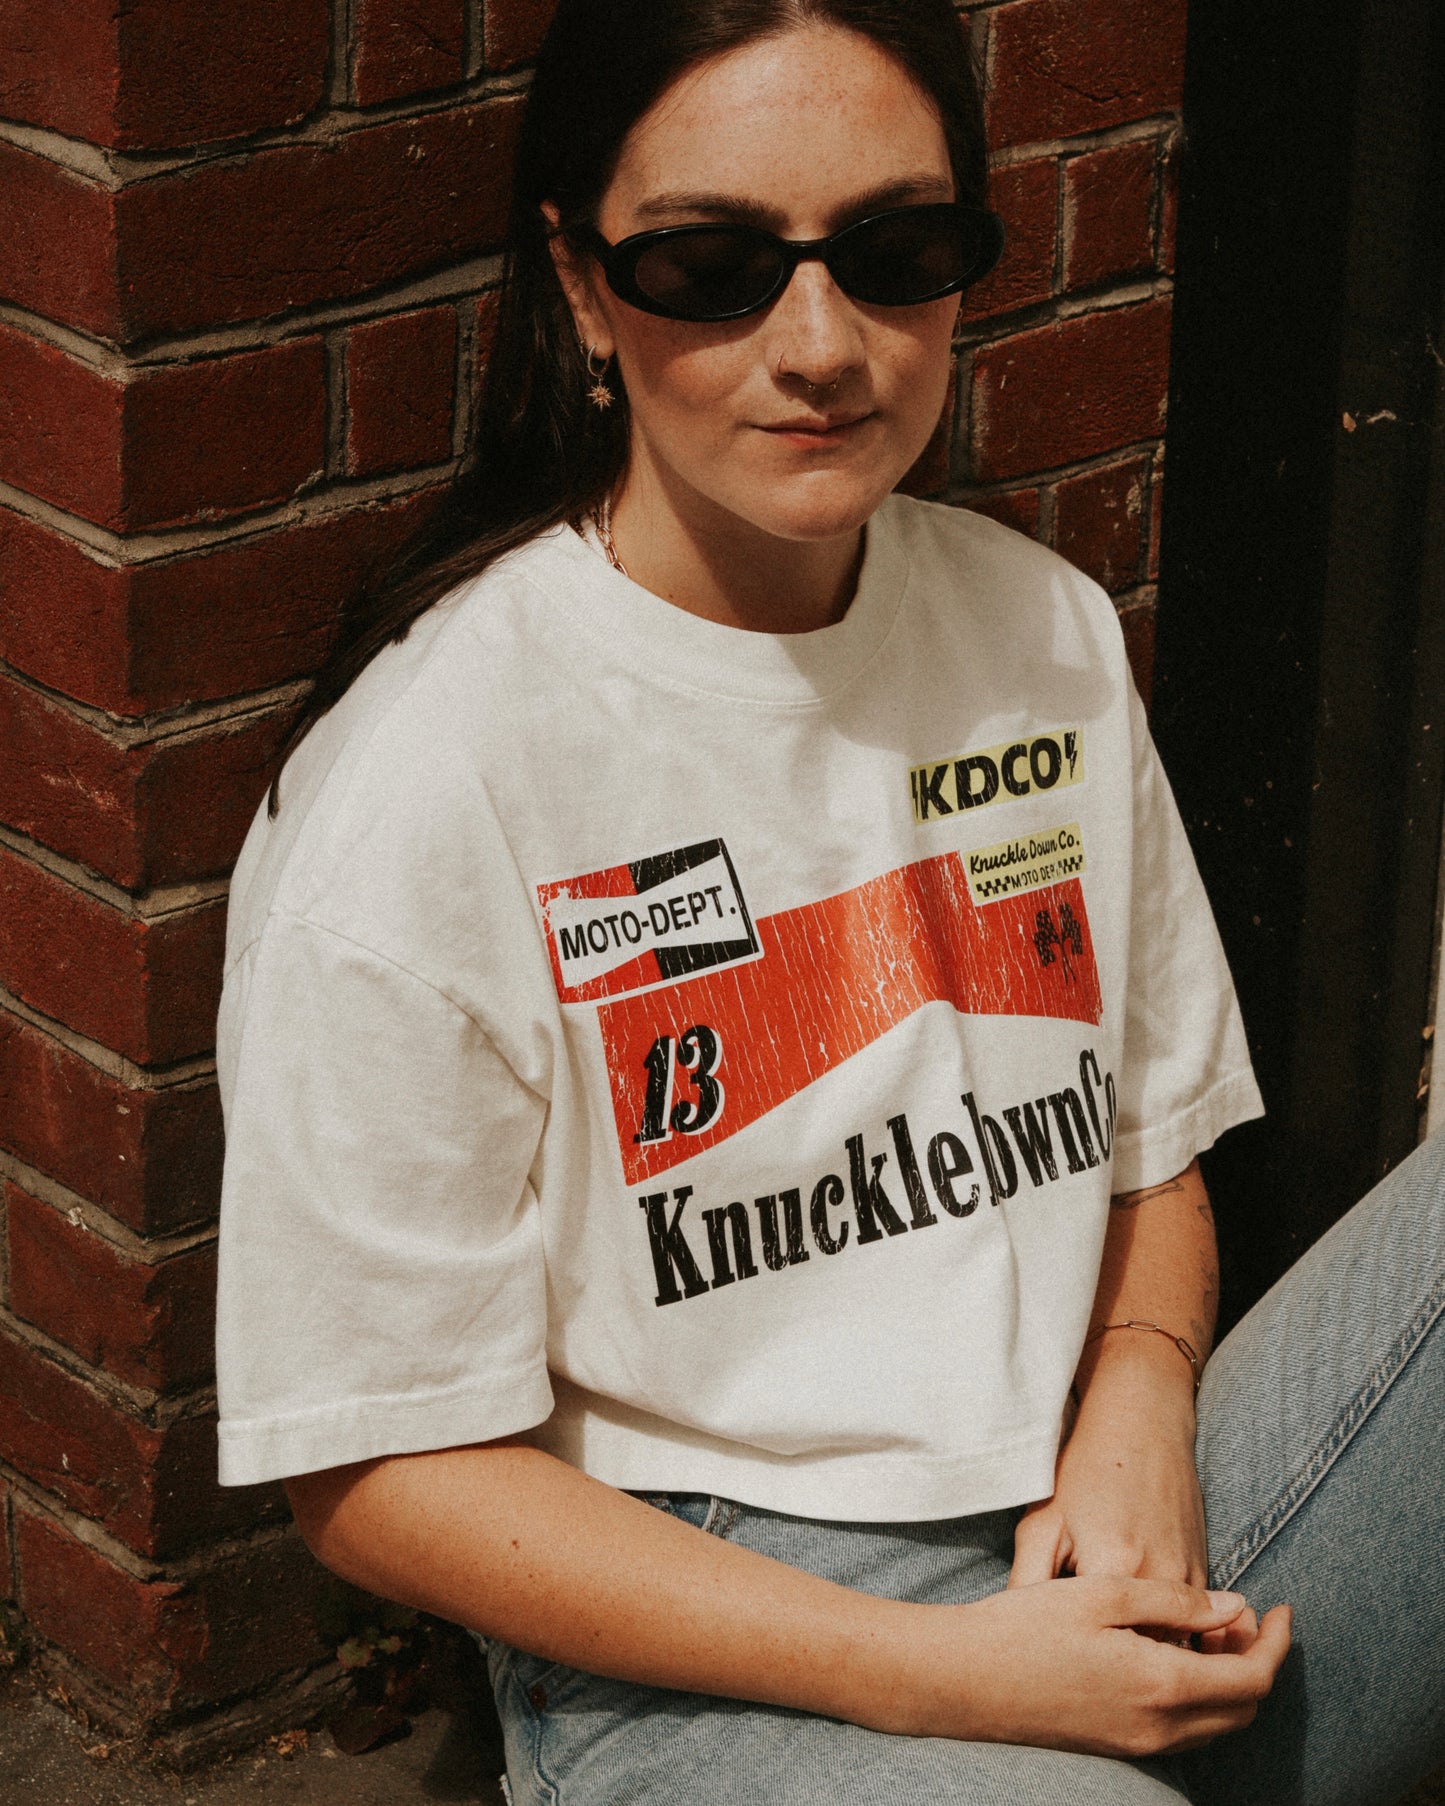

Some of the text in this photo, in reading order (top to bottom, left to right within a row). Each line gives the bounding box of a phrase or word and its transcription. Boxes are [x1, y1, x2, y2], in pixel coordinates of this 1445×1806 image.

[919, 737, 1062, 820] KDCO
[970, 830, 1080, 875] Knuckle Down Co.
[1011, 869, 1039, 889] MOTO
[558, 885, 736, 961] MOTO-DEPT.
[633, 1024, 725, 1146] 13
